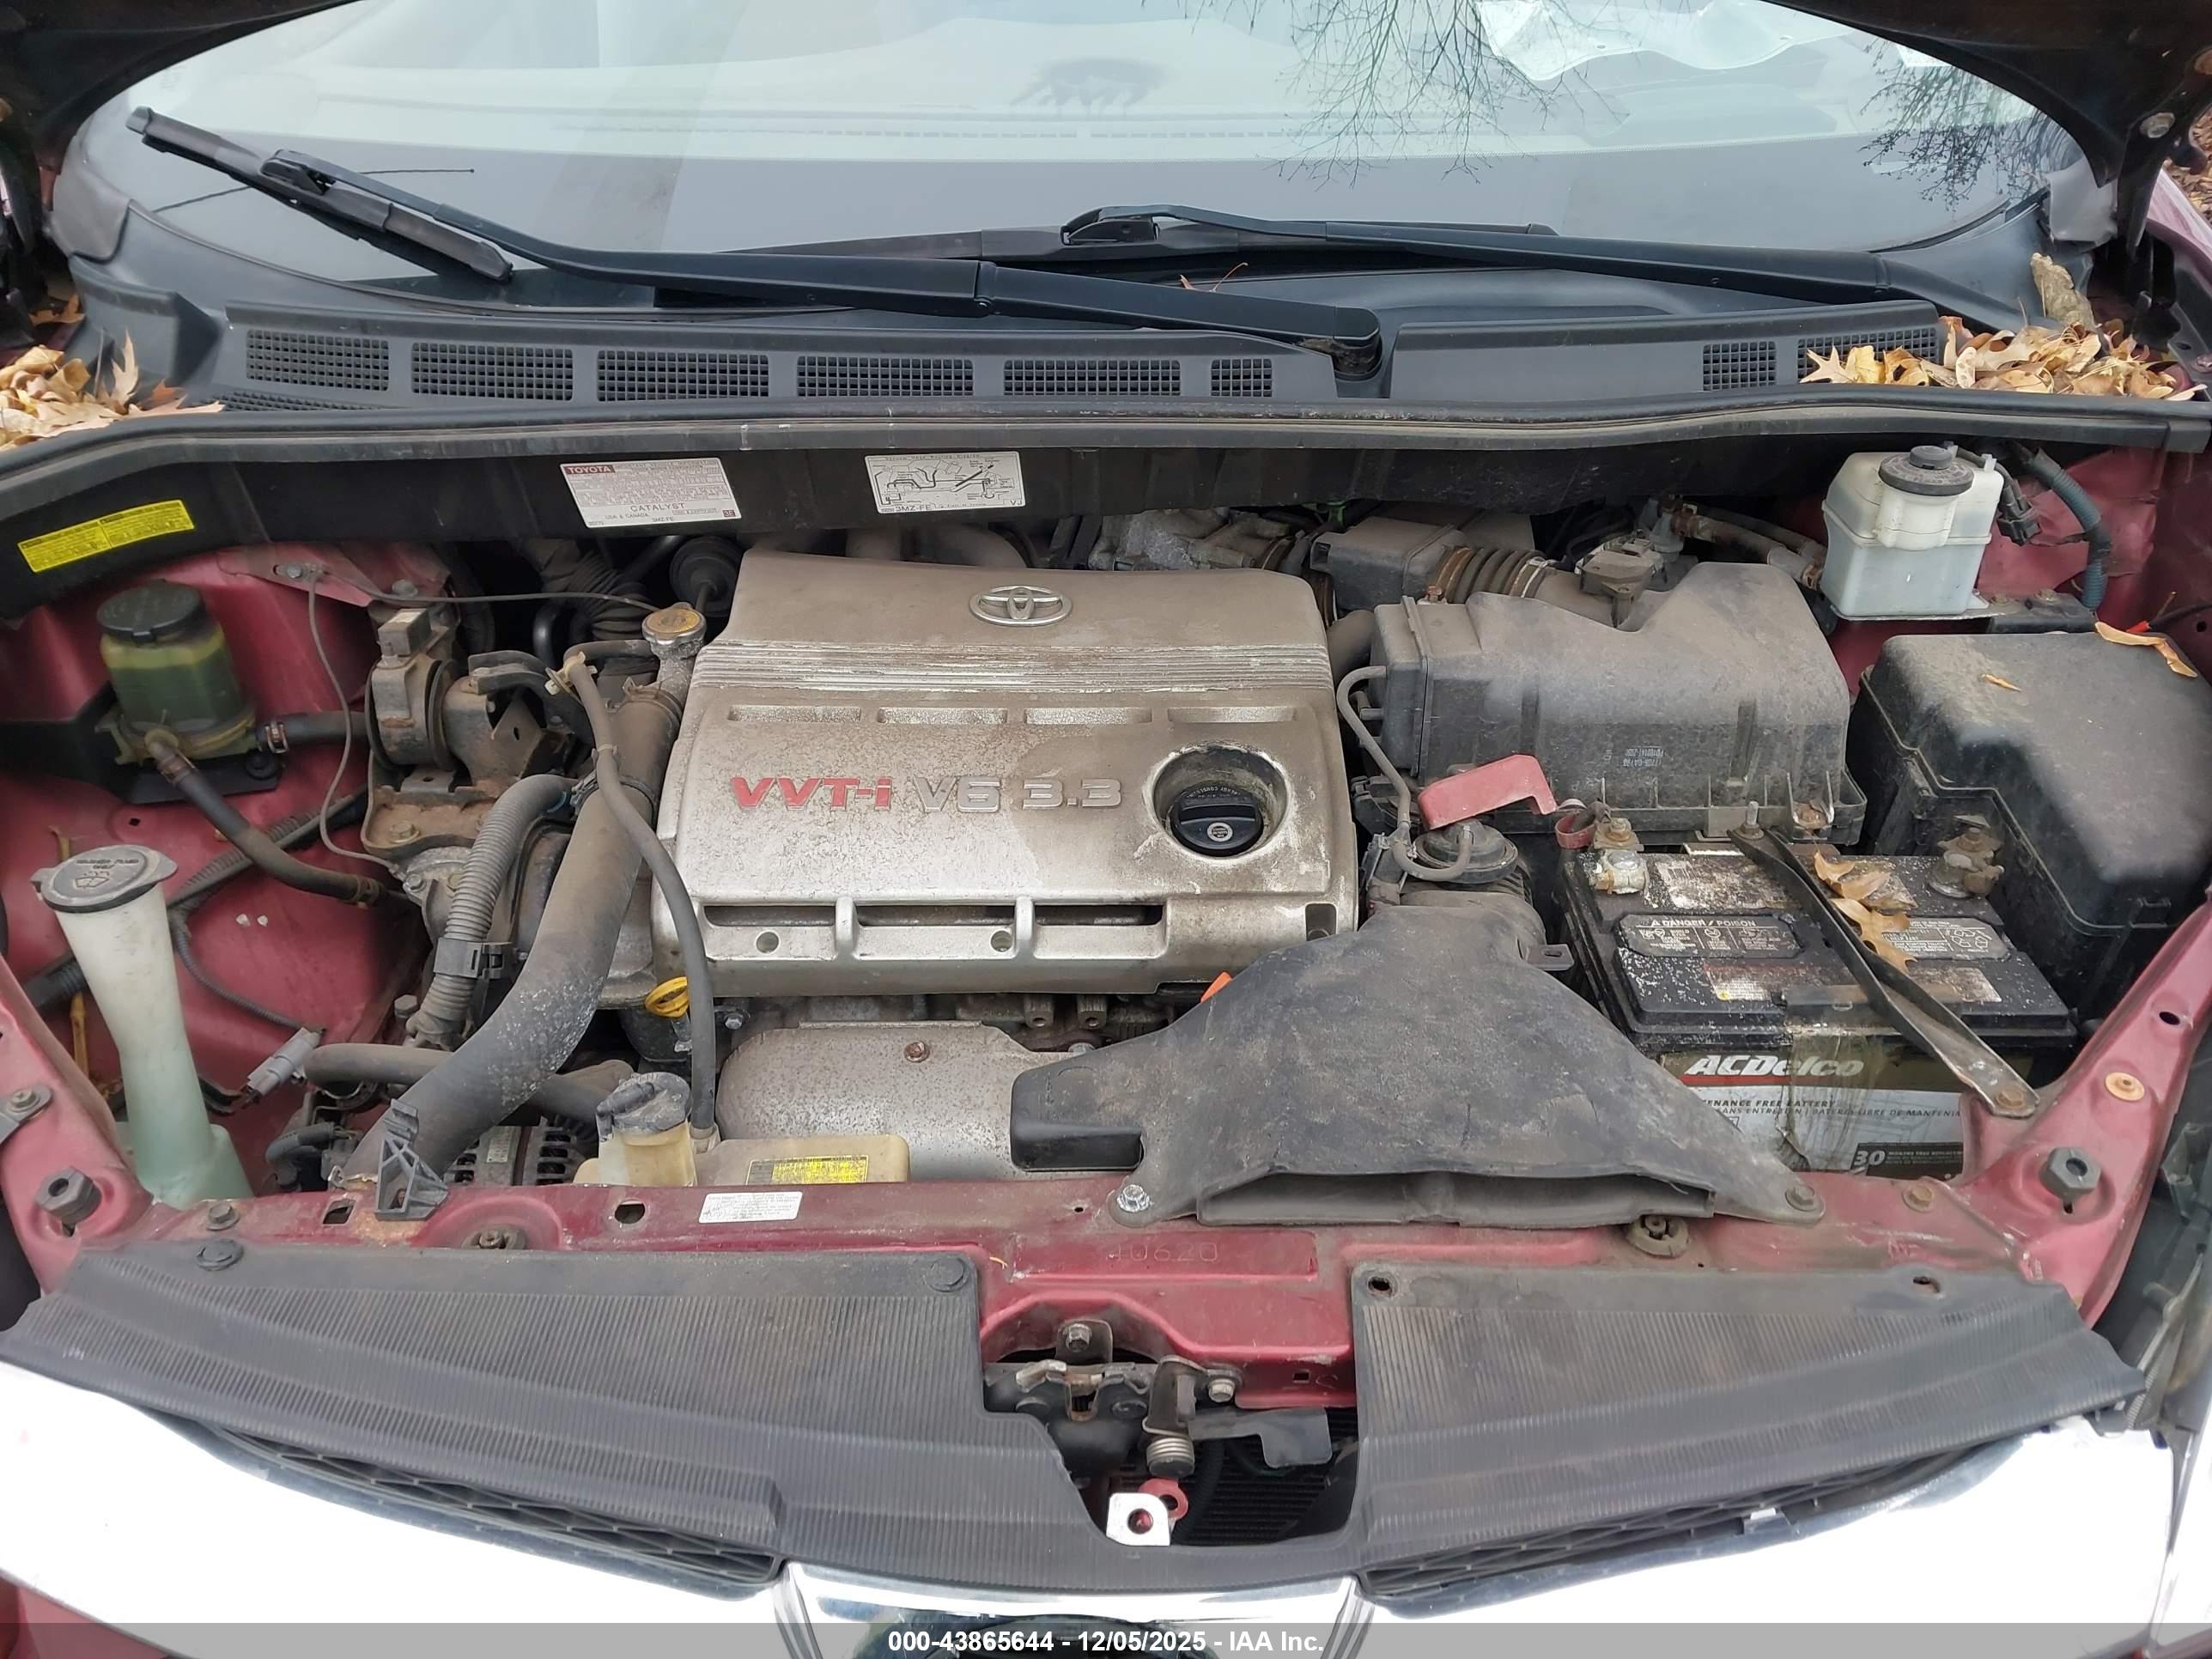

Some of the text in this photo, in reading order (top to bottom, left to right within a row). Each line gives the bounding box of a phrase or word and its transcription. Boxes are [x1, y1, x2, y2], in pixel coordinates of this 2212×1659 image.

[568, 465, 611, 475] TOYOTA
[630, 502, 685, 513] CATALYST
[731, 775, 1122, 812] VVT-i V6 3.3
[1683, 1054, 1864, 1076] ACDelco
[1853, 1150, 1886, 1166] 30
